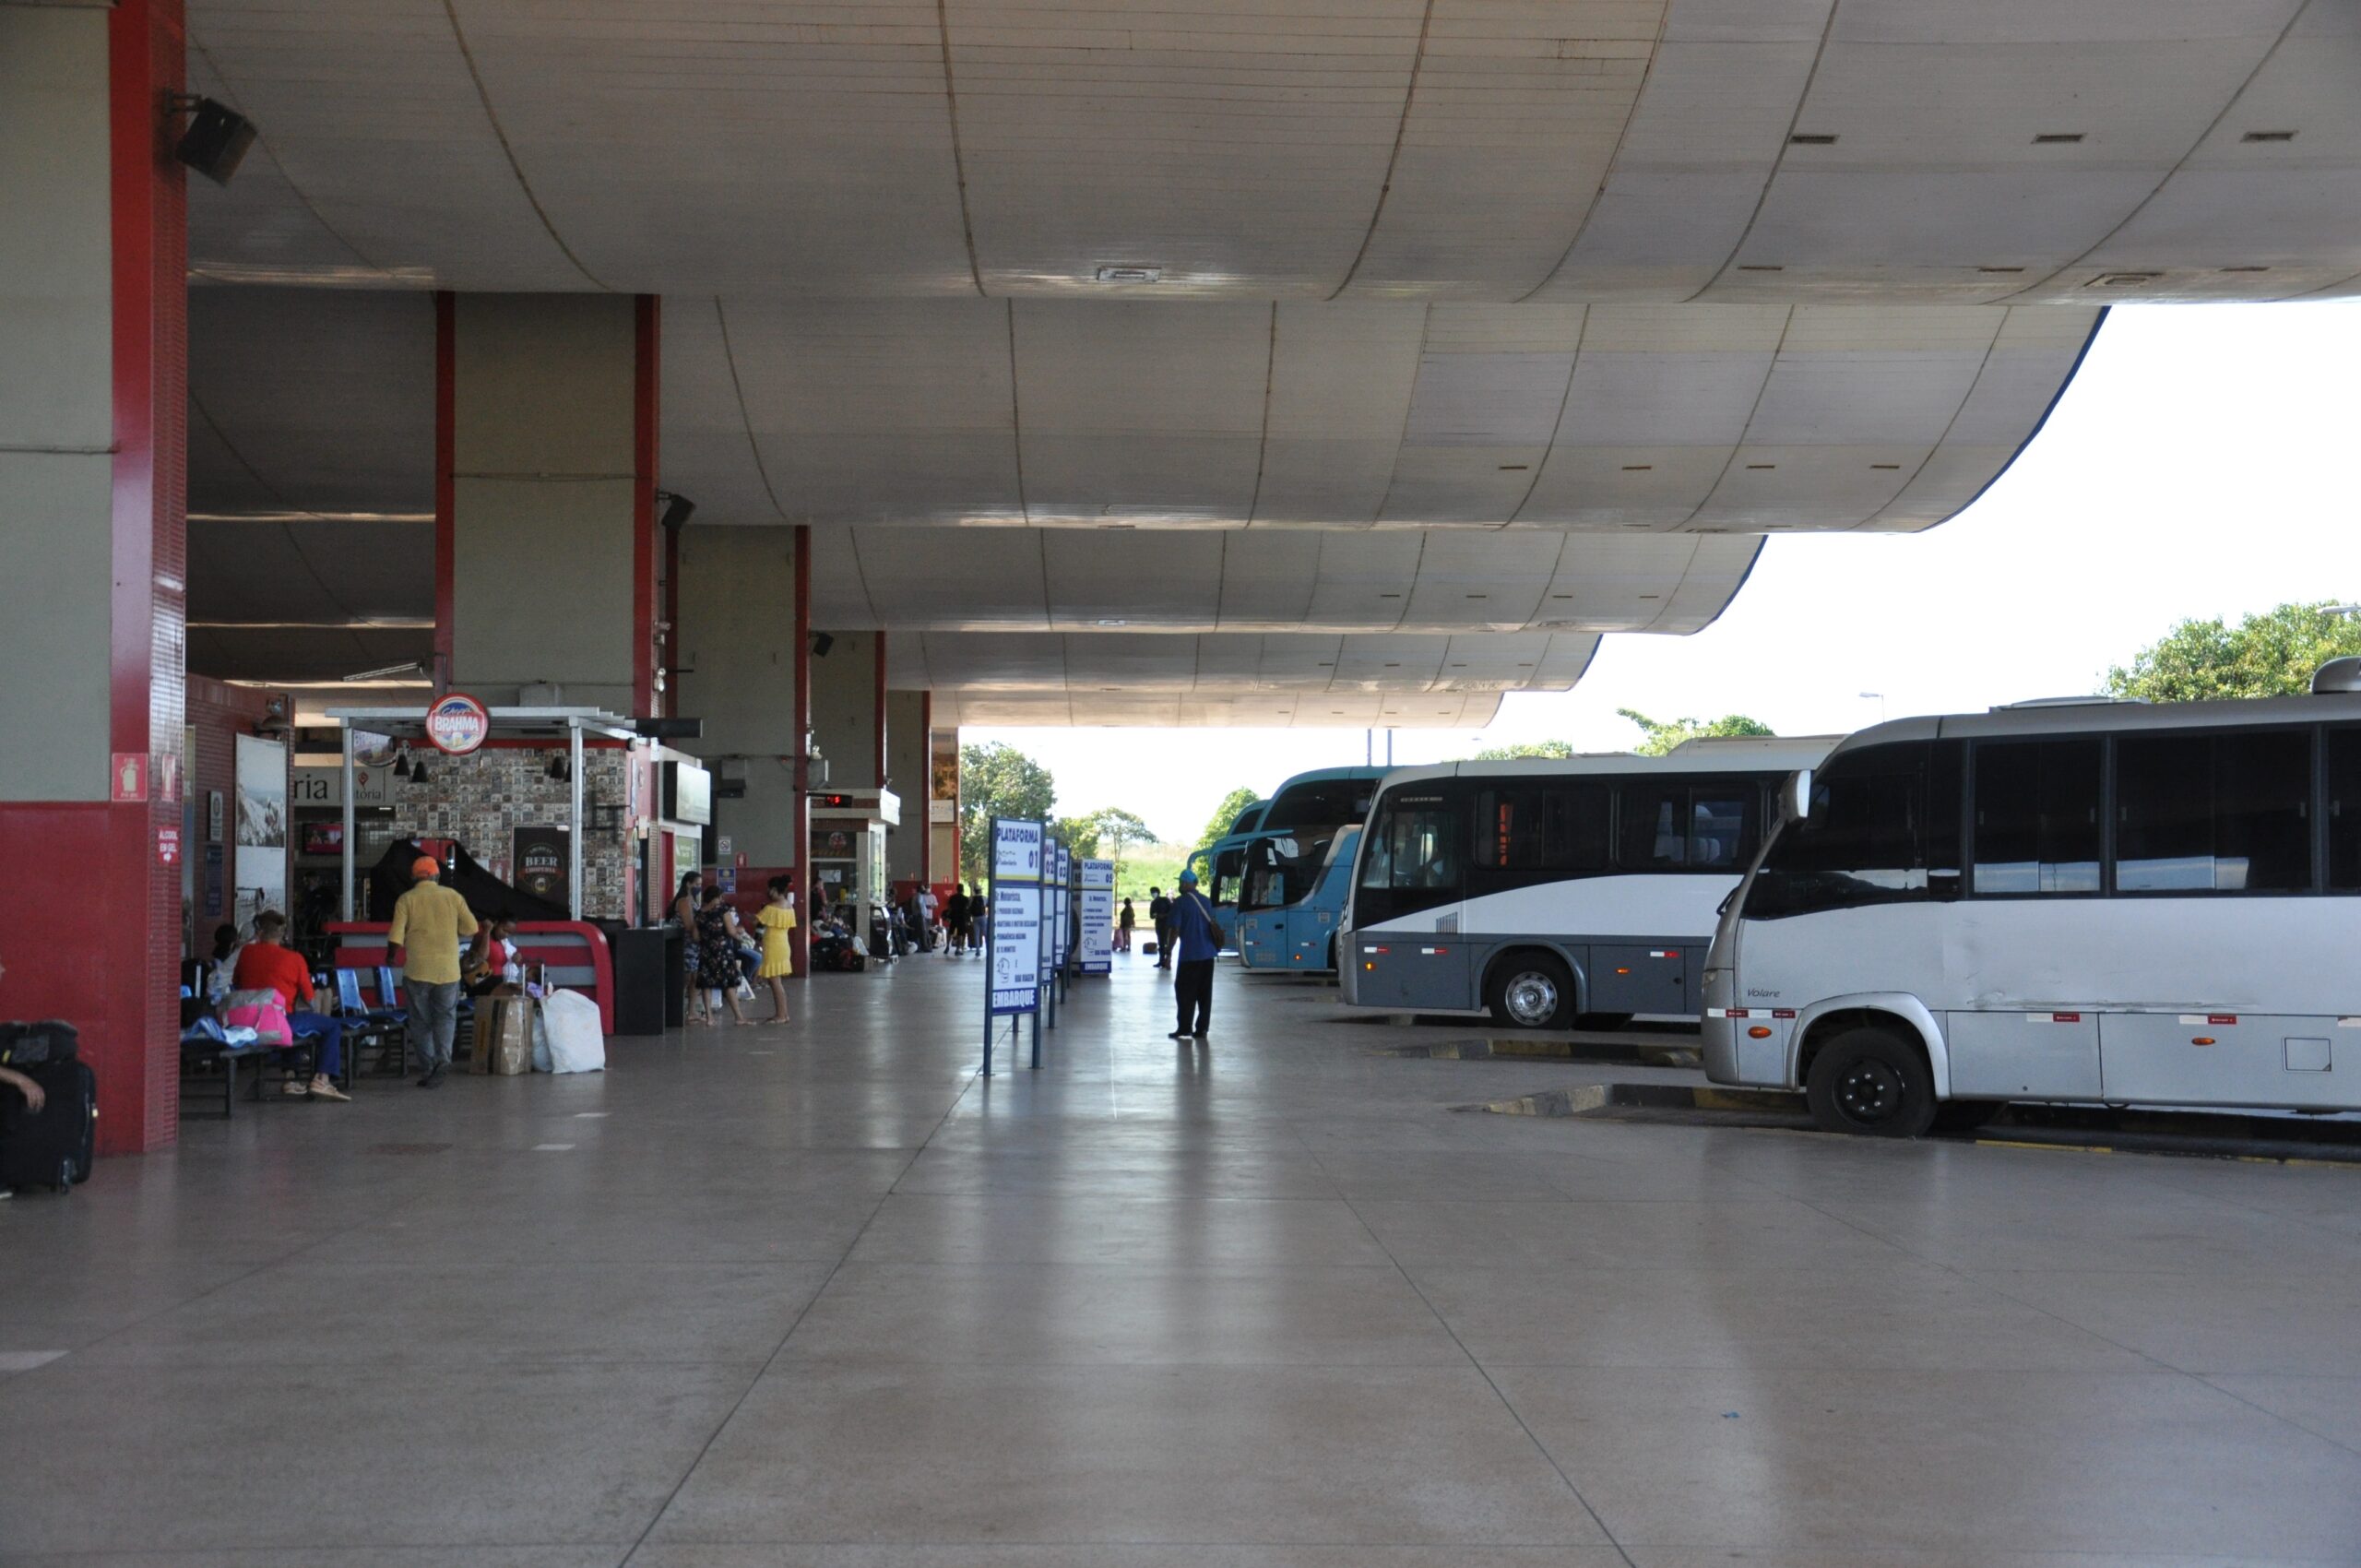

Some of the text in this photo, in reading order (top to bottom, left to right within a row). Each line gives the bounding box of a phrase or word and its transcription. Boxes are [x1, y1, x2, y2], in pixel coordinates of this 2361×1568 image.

[434, 716, 480, 732] BRAHMA
[996, 826, 1038, 843] PLATAFORMA
[525, 856, 557, 867] BEER
[1028, 850, 1038, 868] 01
[1045, 860, 1054, 874] 02
[992, 989, 1035, 1008] EMBARQUE
[1747, 988, 1781, 998] Volare
